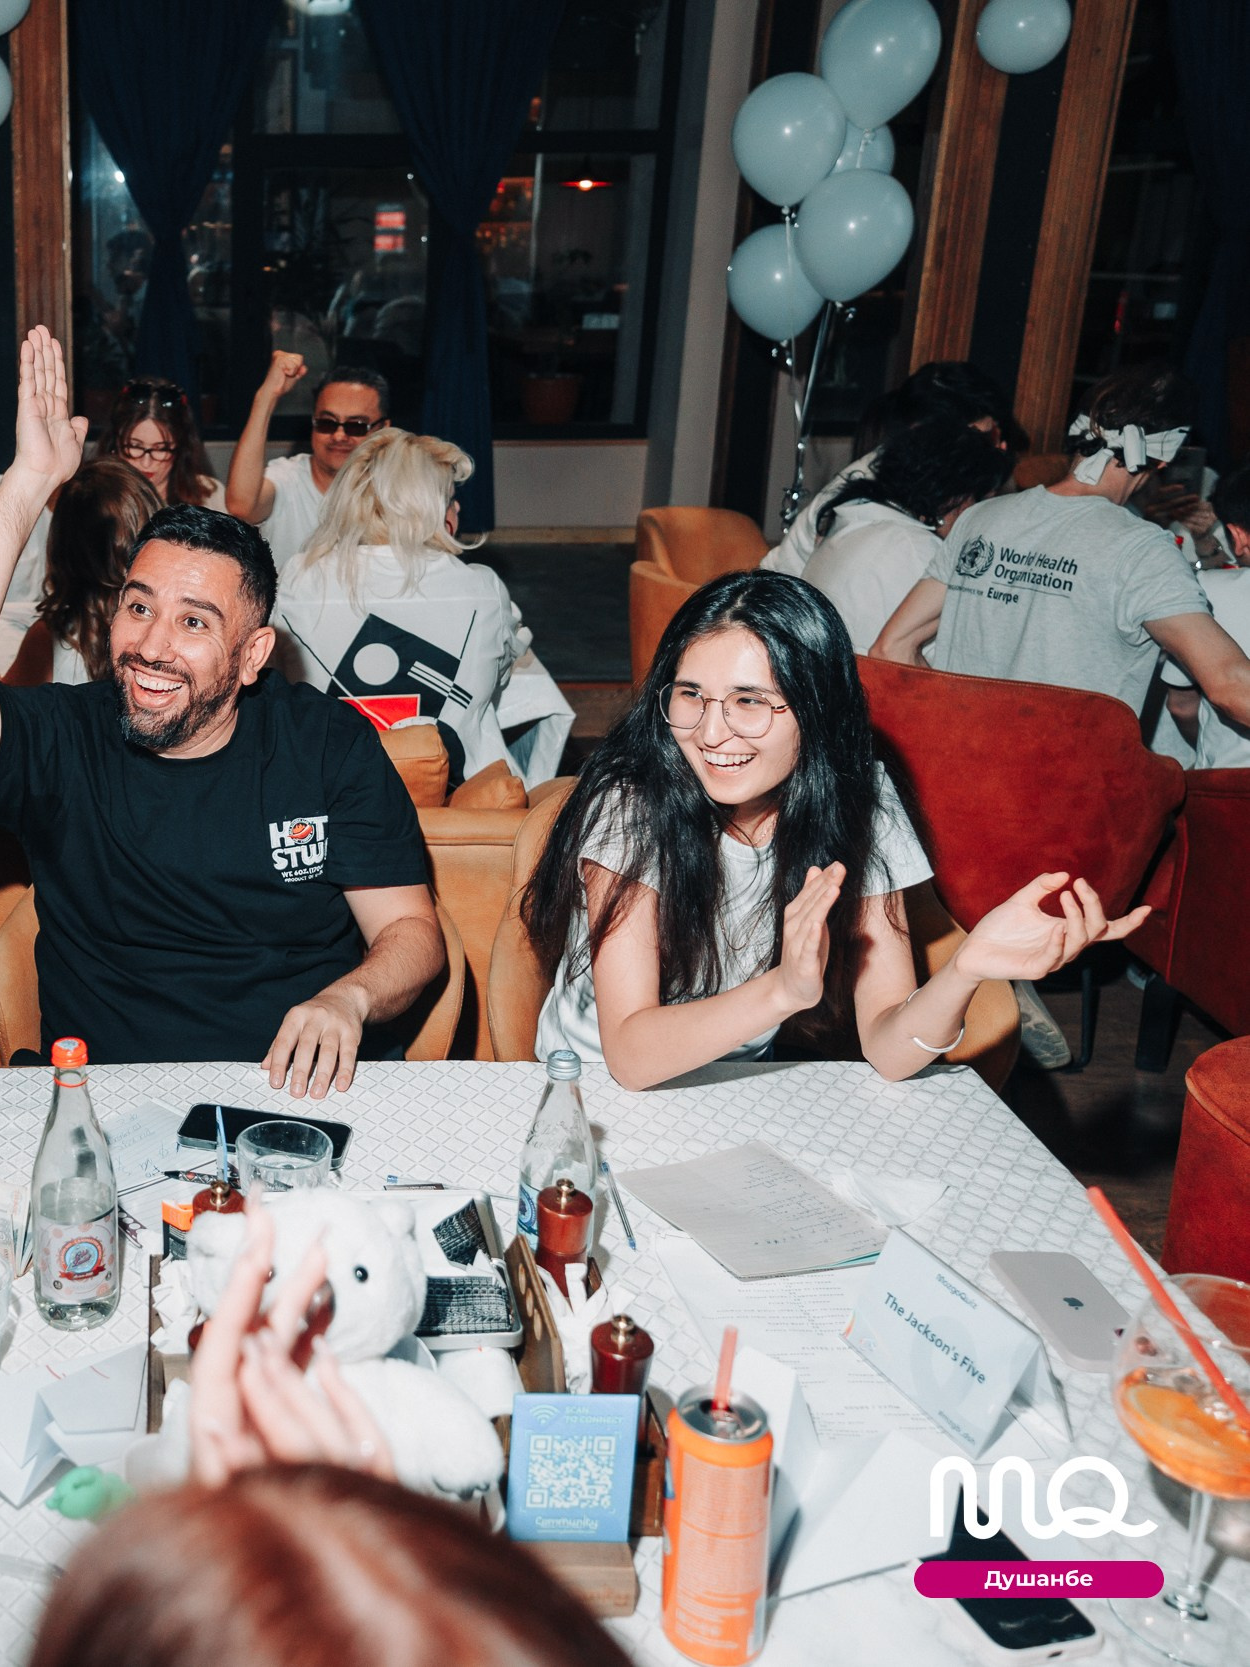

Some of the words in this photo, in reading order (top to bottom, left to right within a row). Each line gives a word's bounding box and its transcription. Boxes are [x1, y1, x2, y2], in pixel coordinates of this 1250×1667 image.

[1000, 547, 1035, 567] World
[1036, 553, 1078, 575] Health
[994, 564, 1073, 592] Organization
[269, 815, 328, 849] HOT
[936, 1273, 978, 1310] MozgoQuiz
[883, 1292, 905, 1317] The
[904, 1312, 959, 1362] Jackson's
[960, 1356, 986, 1384] Five
[566, 1406, 589, 1415] SCAN
[566, 1415, 577, 1424] TO
[579, 1415, 623, 1425] CONNECT
